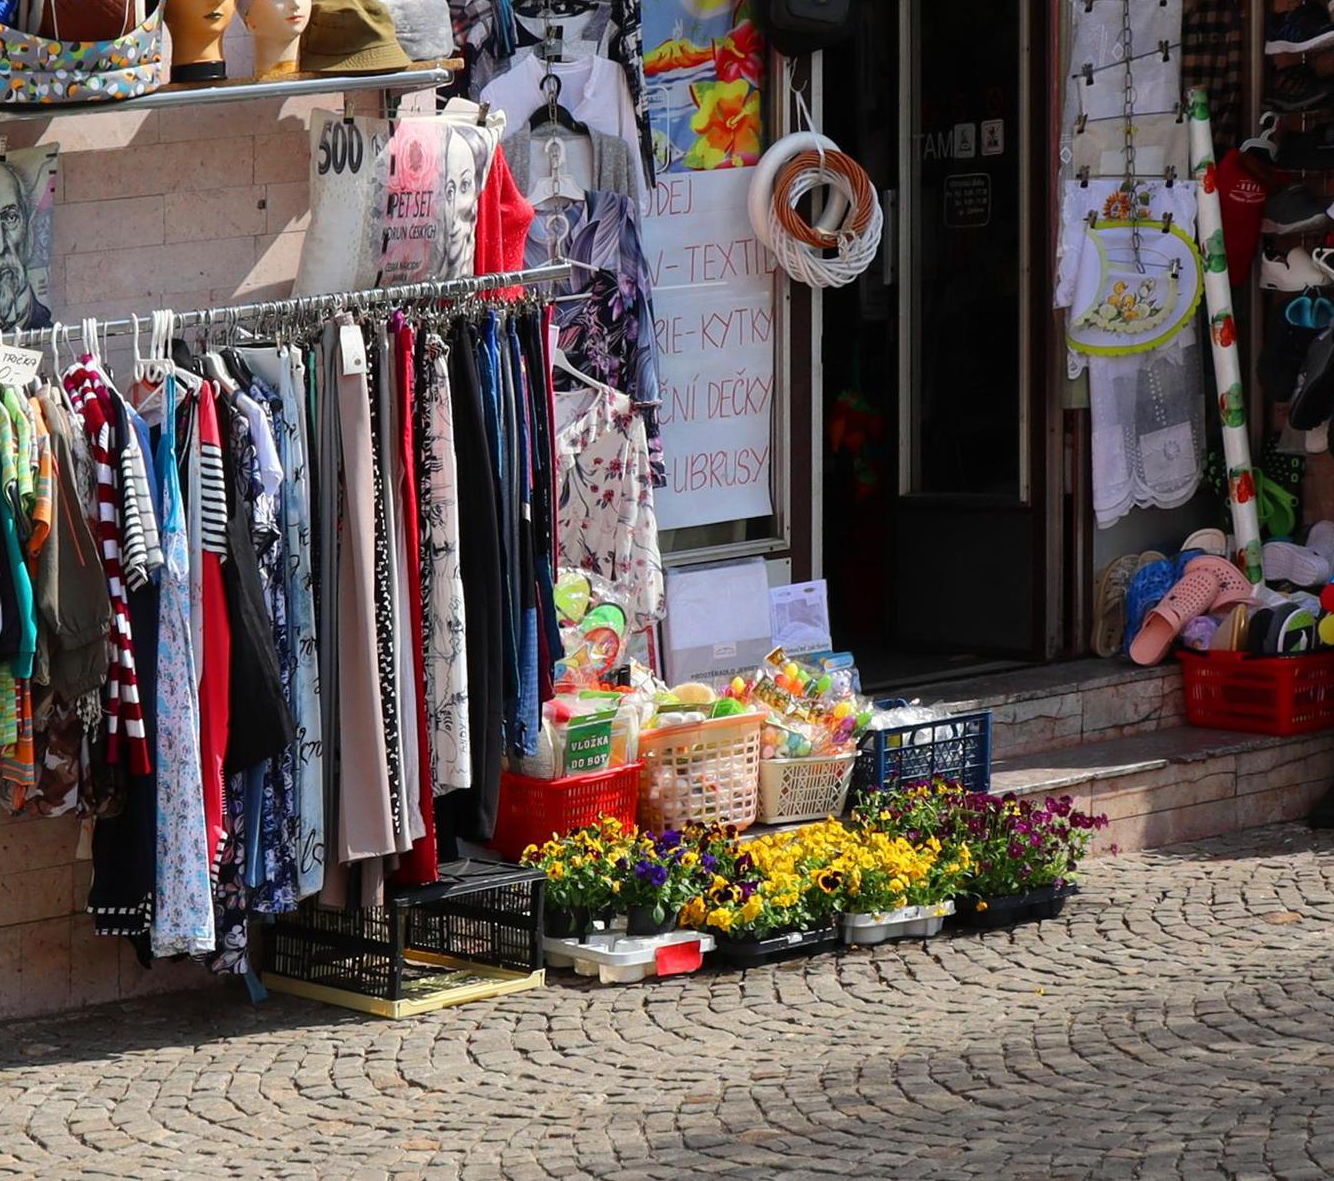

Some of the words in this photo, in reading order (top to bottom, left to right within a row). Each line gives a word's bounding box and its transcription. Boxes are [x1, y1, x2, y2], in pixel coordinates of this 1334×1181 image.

[318, 122, 364, 175] 500
[413, 190, 434, 218] SET
[708, 367, 773, 420] DEČKY
[571, 735, 608, 751] VLOŽKA
[571, 759, 584, 769] DO
[587, 754, 607, 766] BOT
